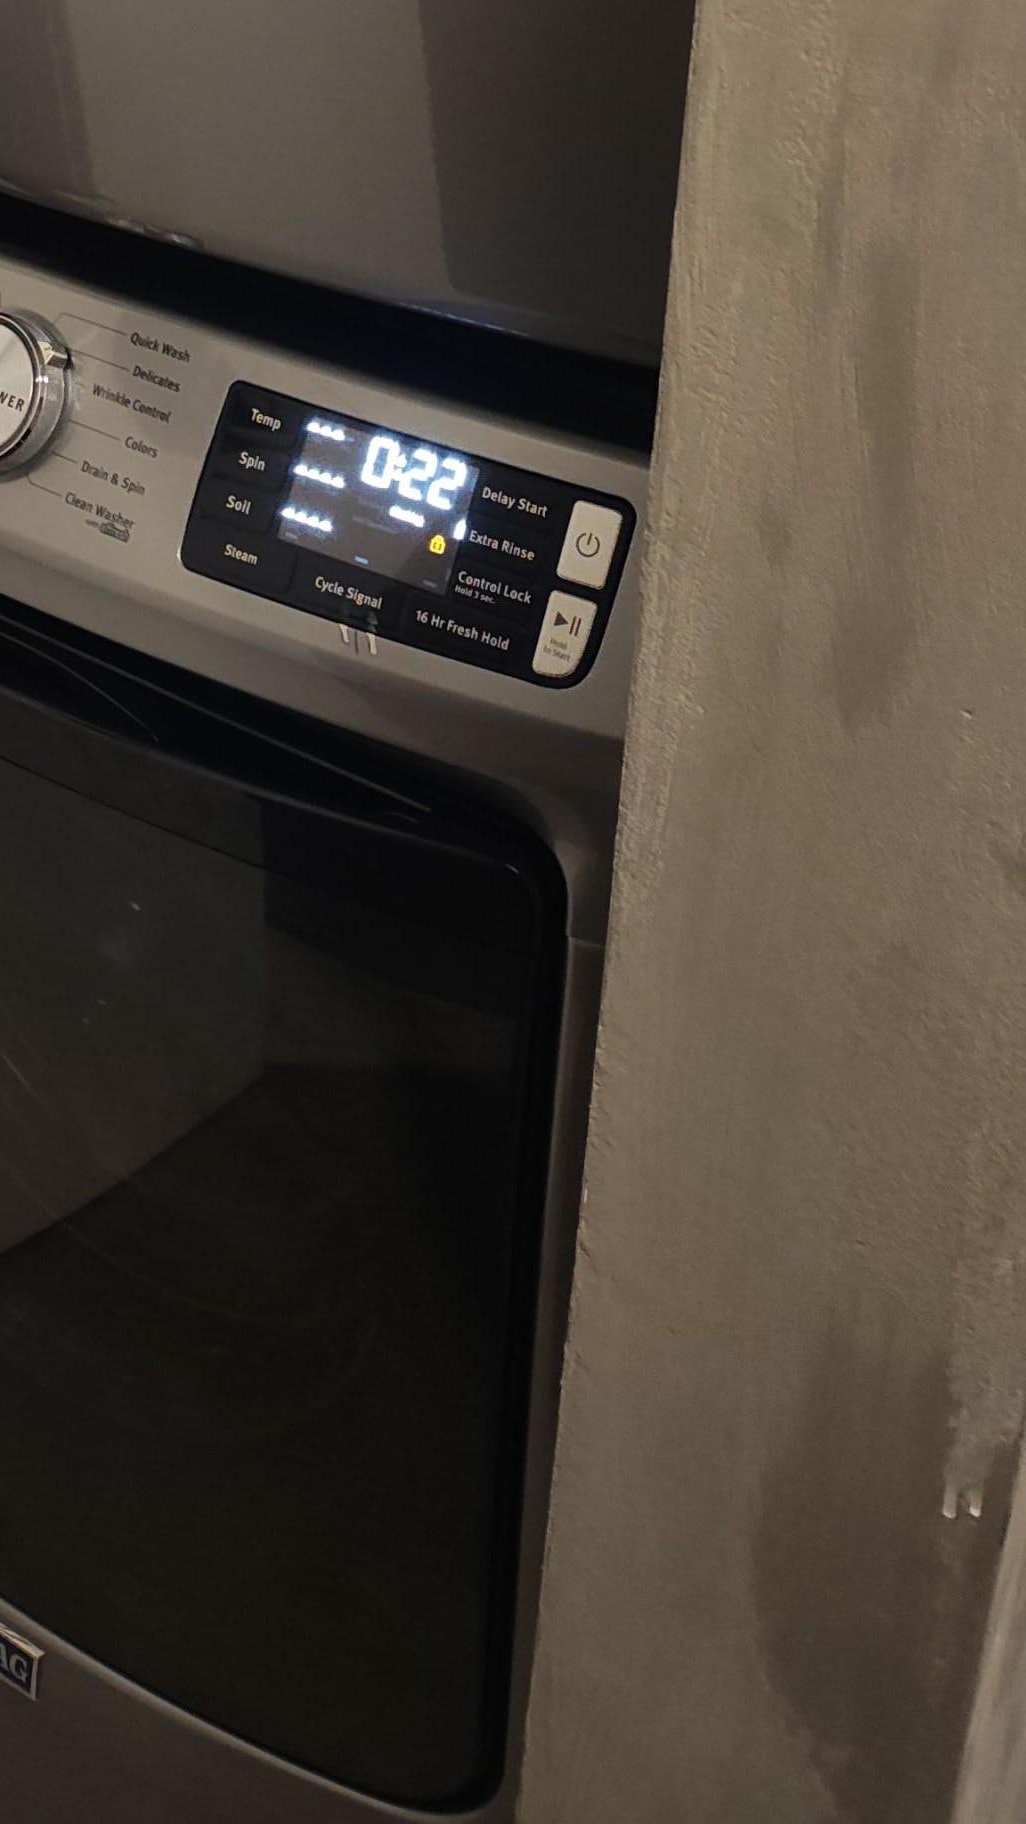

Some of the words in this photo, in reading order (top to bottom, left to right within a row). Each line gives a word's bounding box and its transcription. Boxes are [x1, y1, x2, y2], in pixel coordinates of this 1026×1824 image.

[130, 332, 159, 353] Quick
[162, 342, 191, 363] Wash
[132, 364, 181, 393] Delicates
[92, 383, 131, 409] Wrinkle
[132, 399, 172, 424] Control
[251, 407, 282, 431] Temp
[124, 436, 159, 459] Colors
[238, 450, 266, 471] Spin
[81, 460, 109, 481] Drain
[110, 473, 119, 486] &
[121, 477, 146, 497] Spin
[361, 435, 468, 511] 0:22
[65, 492, 93, 513] Clean
[95, 503, 135, 529] Washer
[225, 495, 252, 515] Soil
[481, 486, 515, 510] Delay
[517, 498, 548, 518] Start
[224, 543, 259, 566] Steam
[469, 529, 499, 550] Extra
[501, 540, 535, 561] Rinse
[315, 575, 345, 597] Cycle
[345, 586, 383, 610] Signal
[454, 584, 473, 597] Hold
[458, 571, 502, 596] Control
[503, 585, 532, 605] Lock
[415, 609, 429, 624] 16
[430, 614, 446, 629] Hr
[446, 619, 479, 640] Fresh
[481, 631, 510, 651] Hold
